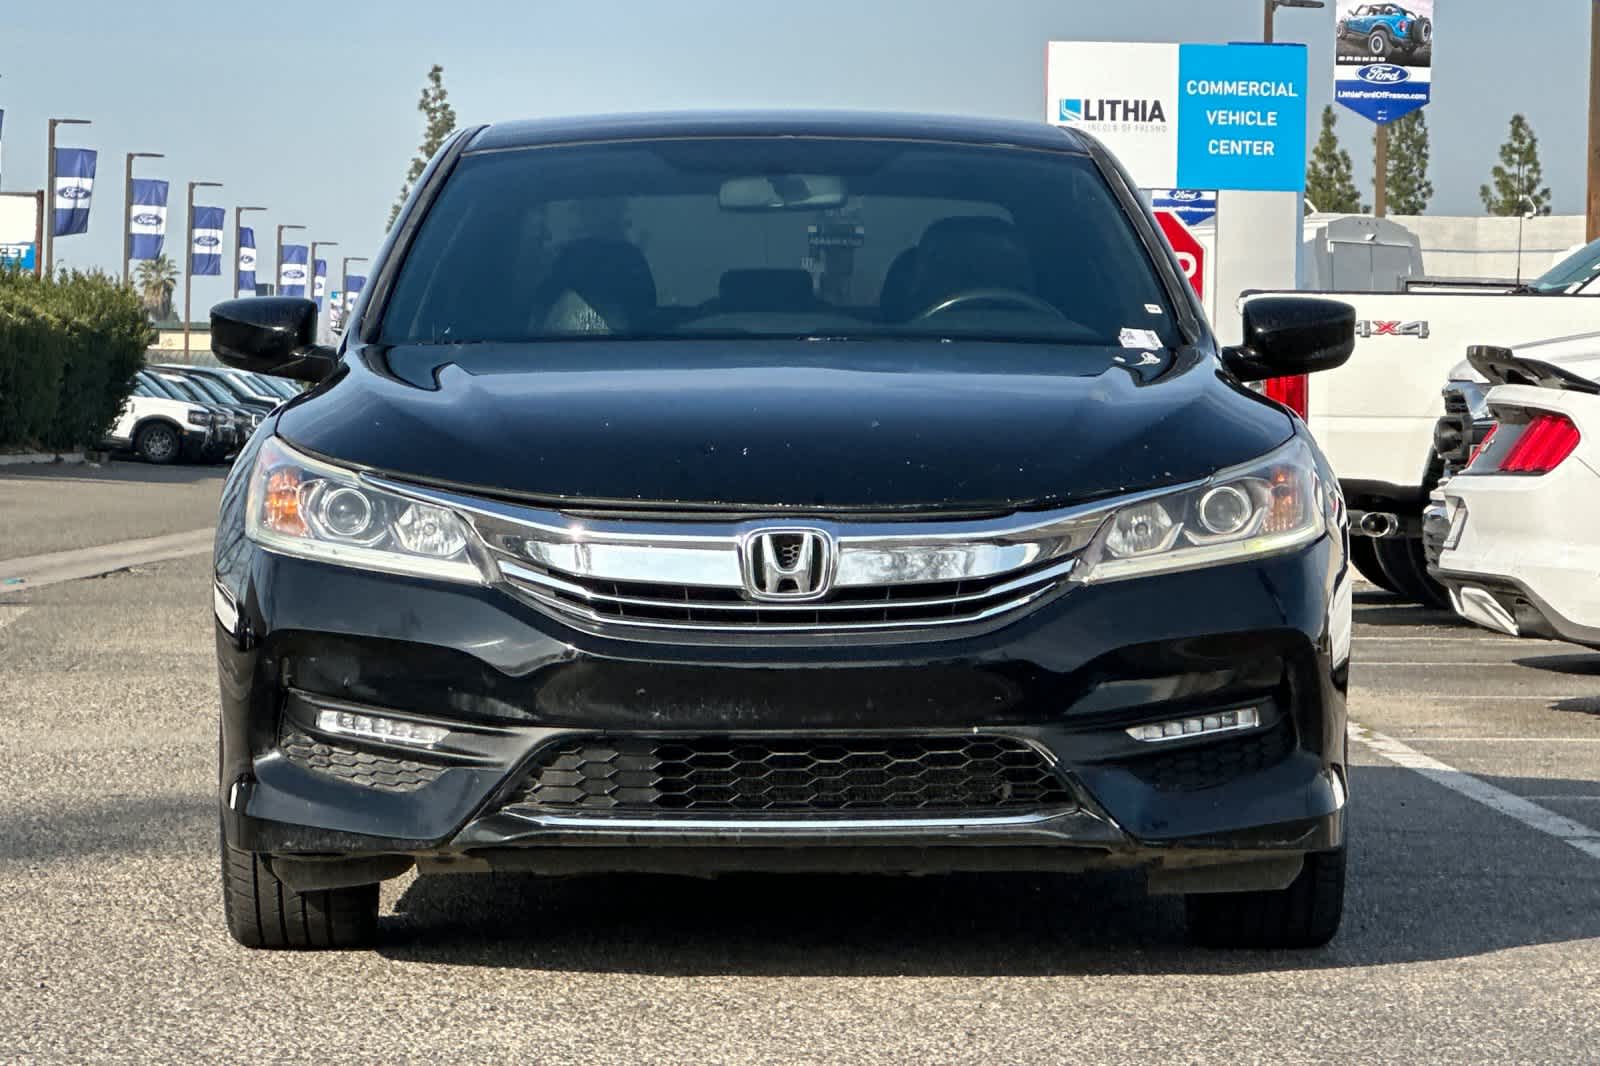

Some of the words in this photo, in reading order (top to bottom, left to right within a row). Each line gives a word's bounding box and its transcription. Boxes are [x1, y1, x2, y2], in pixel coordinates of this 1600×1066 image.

[1366, 65, 1401, 81] Ford
[1186, 80, 1298, 98] COMMERCIAL
[1084, 99, 1166, 122] LITHIA
[1206, 110, 1278, 126] VEHICLE
[1207, 139, 1275, 156] CENTER
[62, 186, 86, 199] Ford
